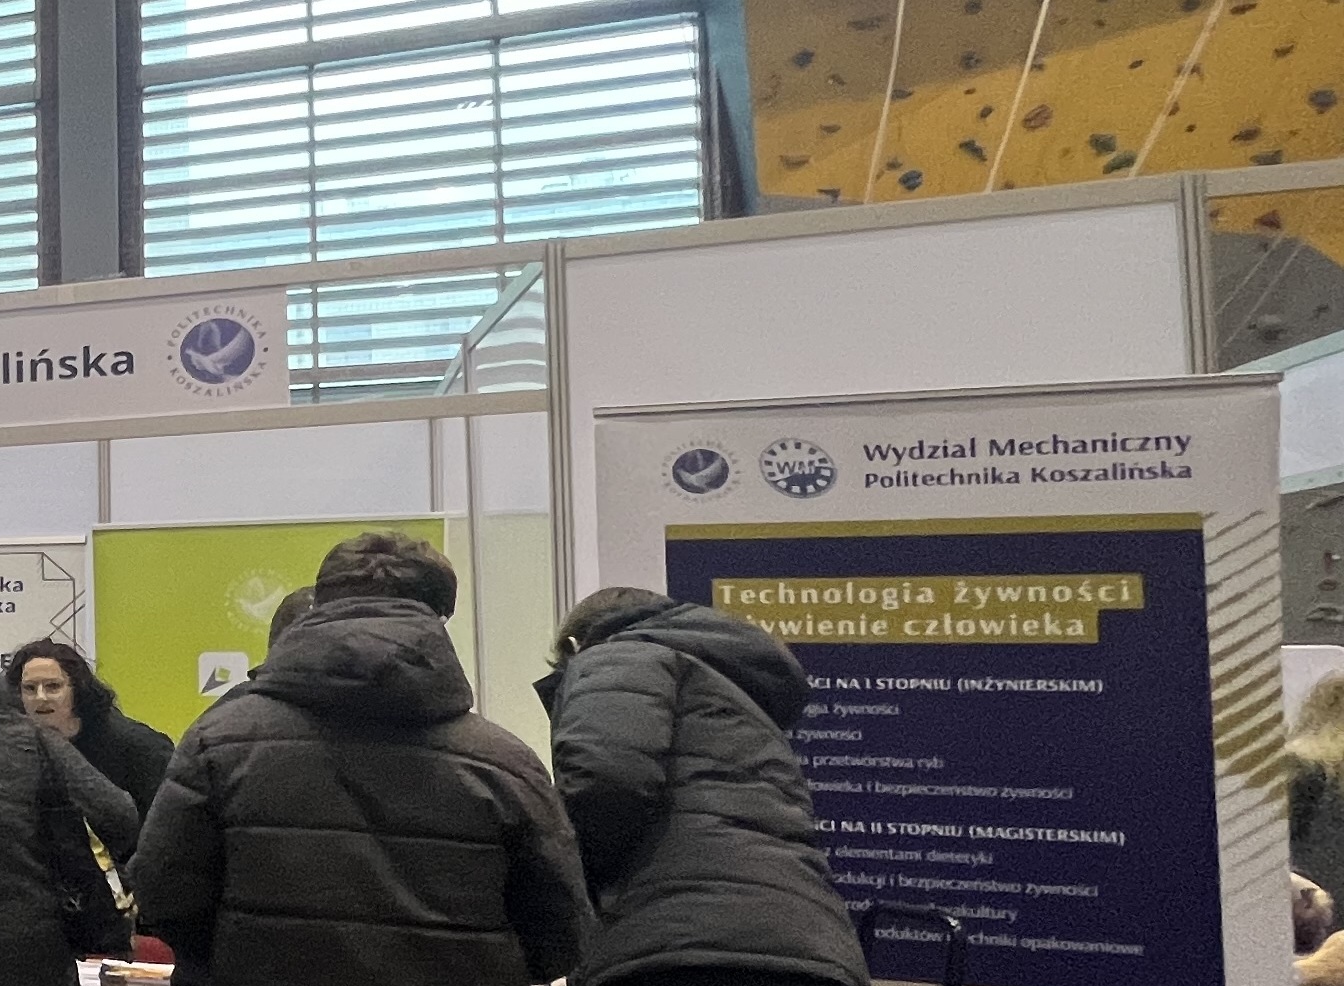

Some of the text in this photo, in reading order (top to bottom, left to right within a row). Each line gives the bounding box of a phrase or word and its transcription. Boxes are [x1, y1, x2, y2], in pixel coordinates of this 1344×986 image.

[989, 432, 1192, 457] Mechaniczny
[864, 460, 1193, 488] Politechnika Koszalińska
[718, 578, 1131, 610] Technologia żywności
[746, 613, 1086, 637] ywienie człowieka
[836, 678, 861, 690] NA
[875, 678, 952, 691] STOPNIU
[957, 676, 1104, 694] (INŻYNIERSKIM)
[841, 821, 865, 833] NA
[871, 822, 883, 834] II
[887, 823, 962, 838] STOPNIU
[968, 825, 1126, 847] (MAGISTERSKIM)
